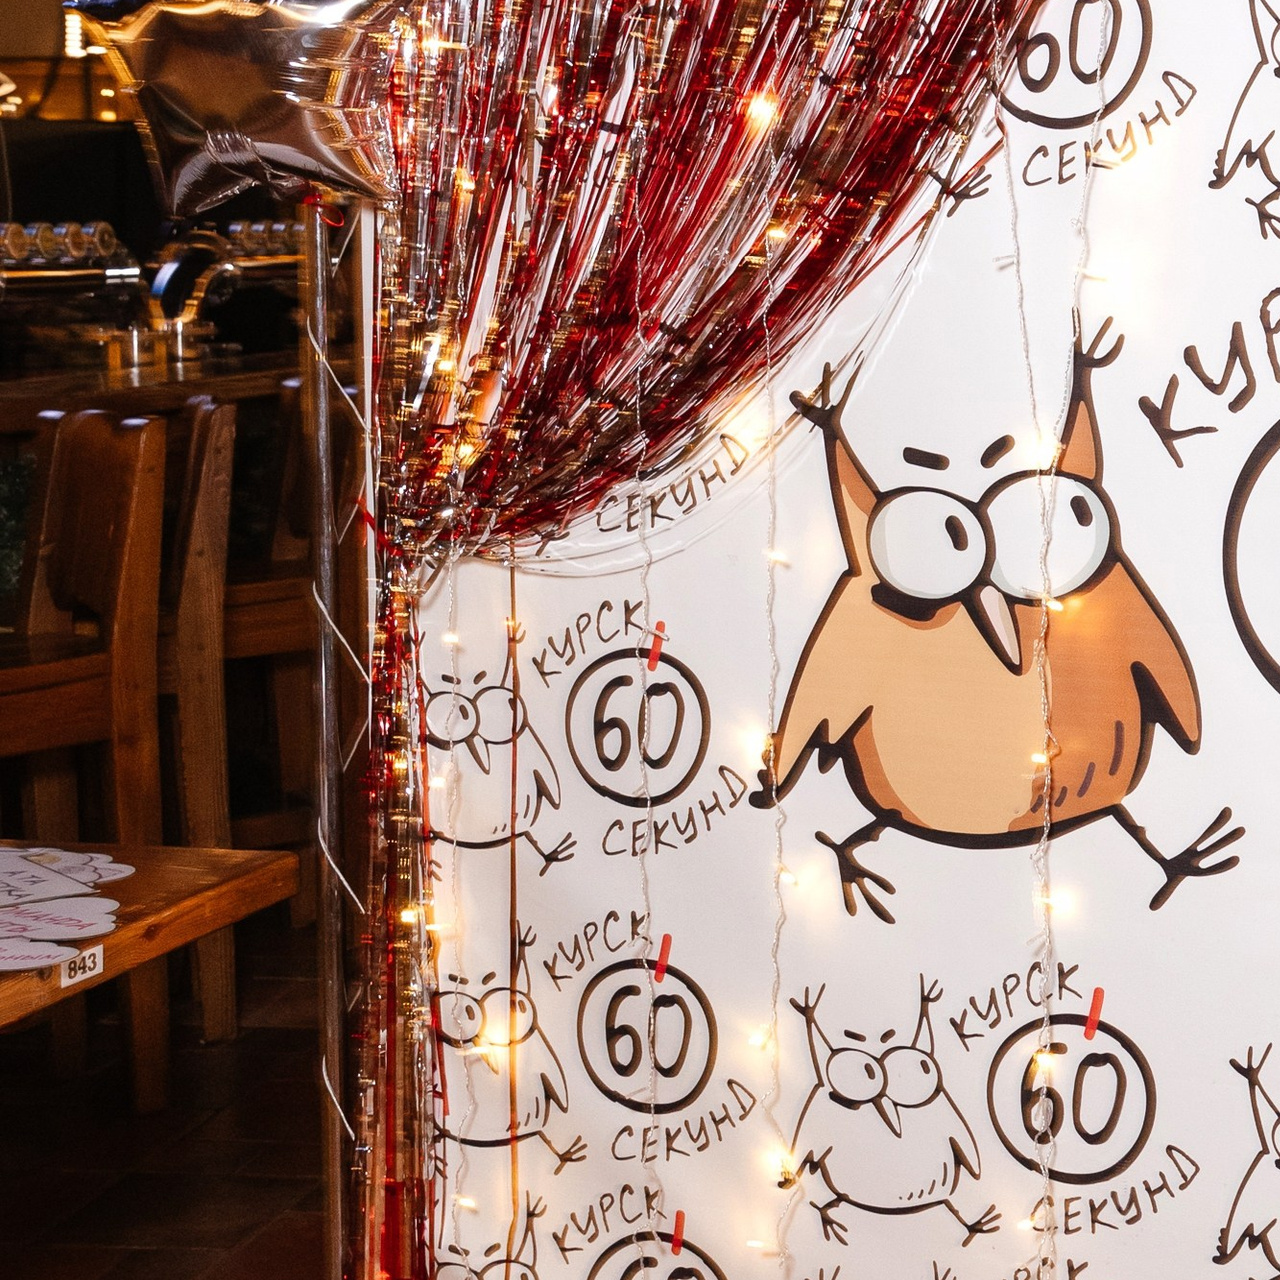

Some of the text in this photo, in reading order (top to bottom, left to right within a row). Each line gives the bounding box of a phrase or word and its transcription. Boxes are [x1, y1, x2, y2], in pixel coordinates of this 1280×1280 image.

[1022, 70, 1197, 187] СЕКУНД
[595, 432, 750, 534] СЕКУНД
[532, 600, 643, 687] КУРСК
[593, 675, 685, 771] 60
[602, 765, 748, 857] СЕКУНД
[68, 952, 97, 980] 843
[543, 910, 652, 991] КУРСК
[605, 985, 692, 1077] 60
[949, 962, 1083, 1051] КУРСК
[611, 1079, 757, 1163] СЕКУНД
[1021, 1042, 1127, 1144] 60
[552, 1184, 667, 1263] КУРСК
[1031, 1144, 1200, 1235] СЕКУНД
